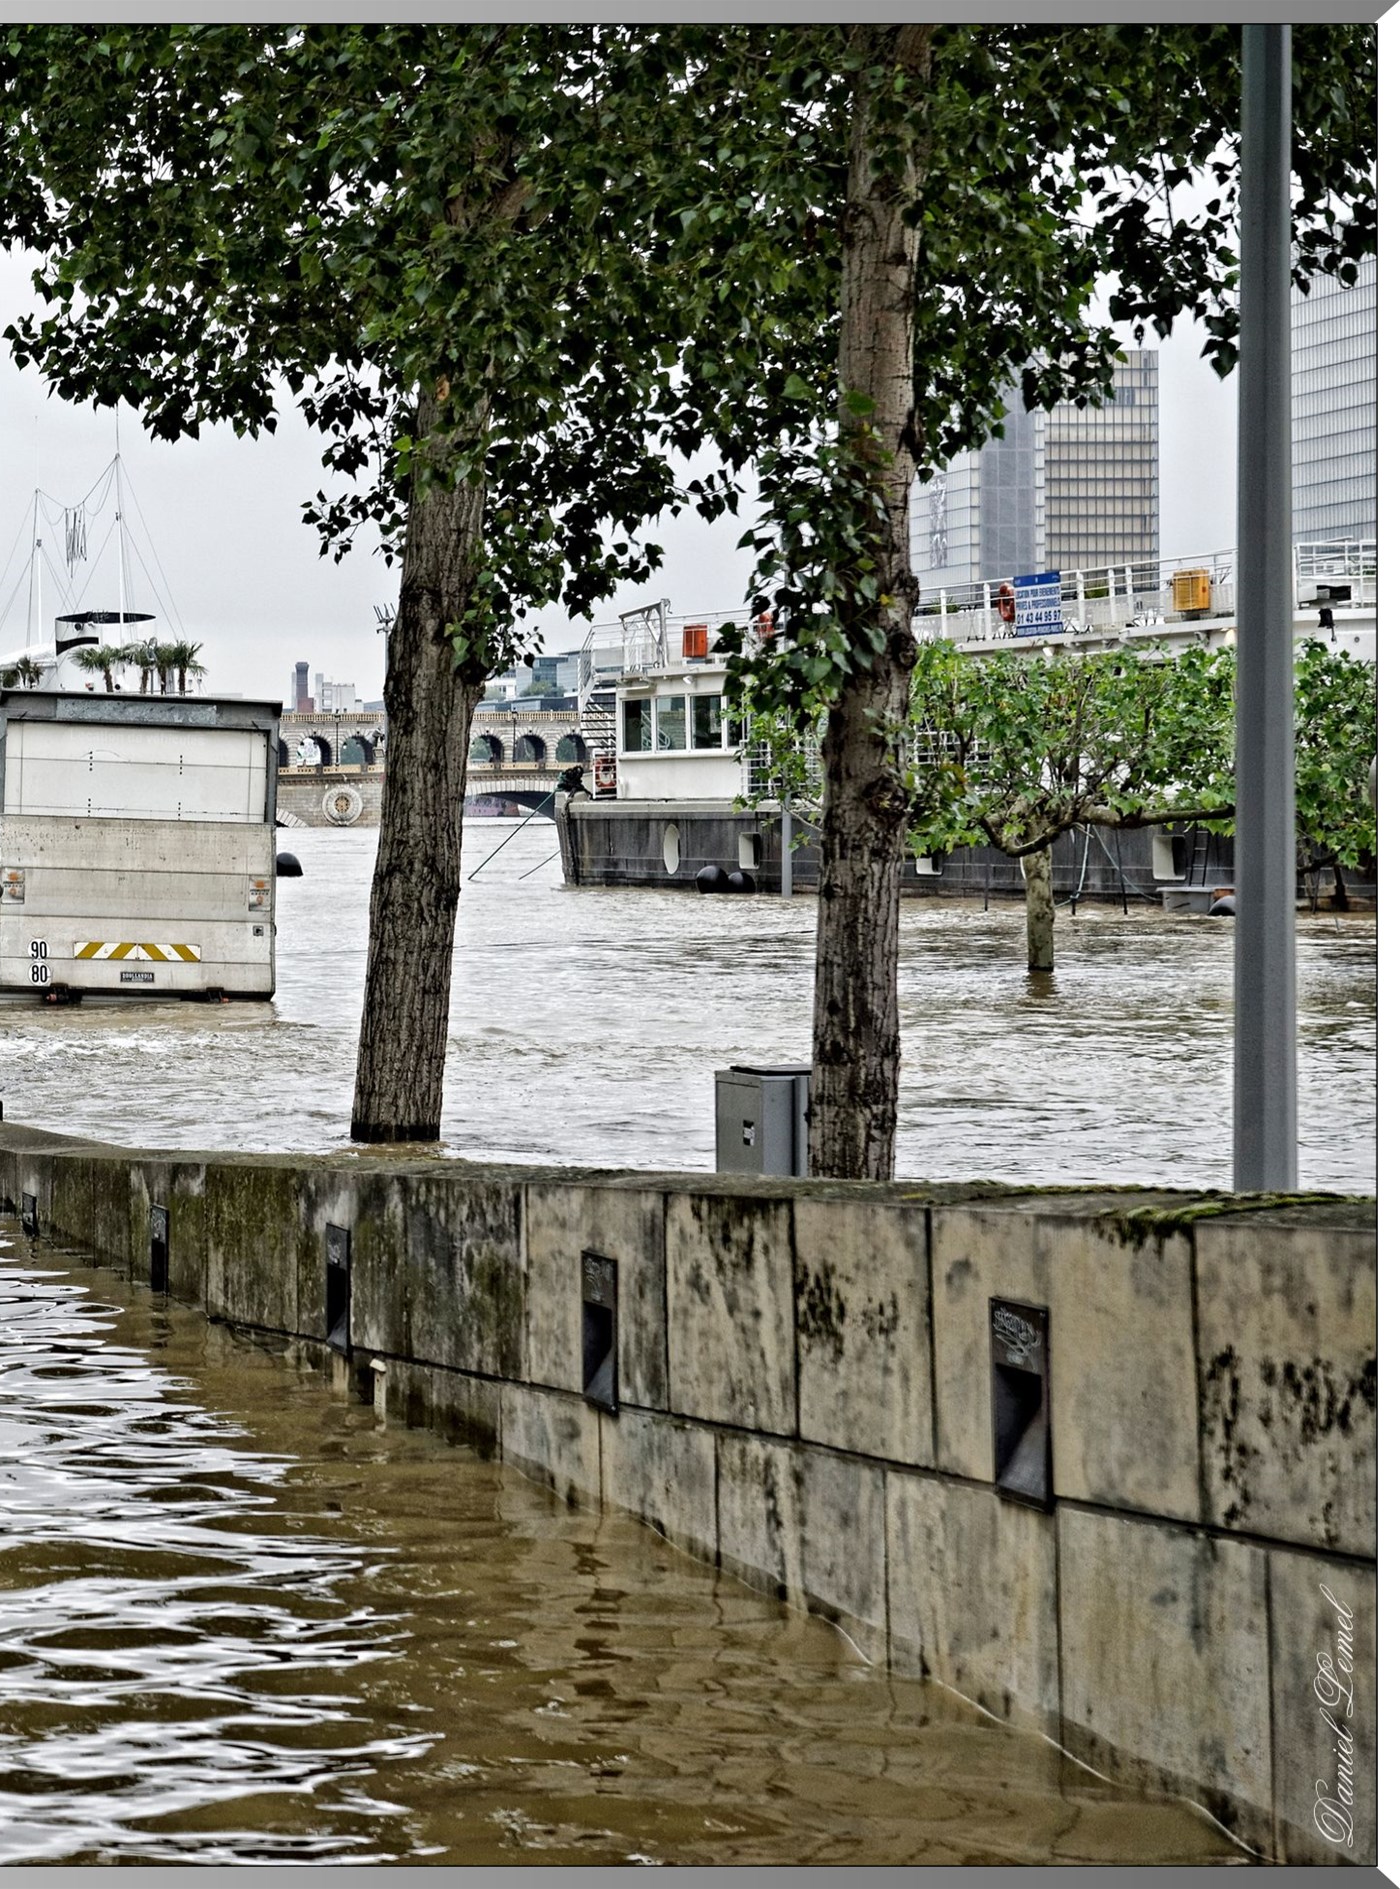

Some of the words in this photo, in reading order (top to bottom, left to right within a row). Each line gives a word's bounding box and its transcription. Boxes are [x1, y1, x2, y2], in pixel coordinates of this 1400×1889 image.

[1017, 614, 1024, 624] 01
[1026, 613, 1033, 623] 43
[1035, 612, 1042, 622] 44
[1044, 611, 1052, 621] 95
[1053, 610, 1061, 620] 97
[31, 941, 48, 960] 90
[31, 964, 48, 983] 80
